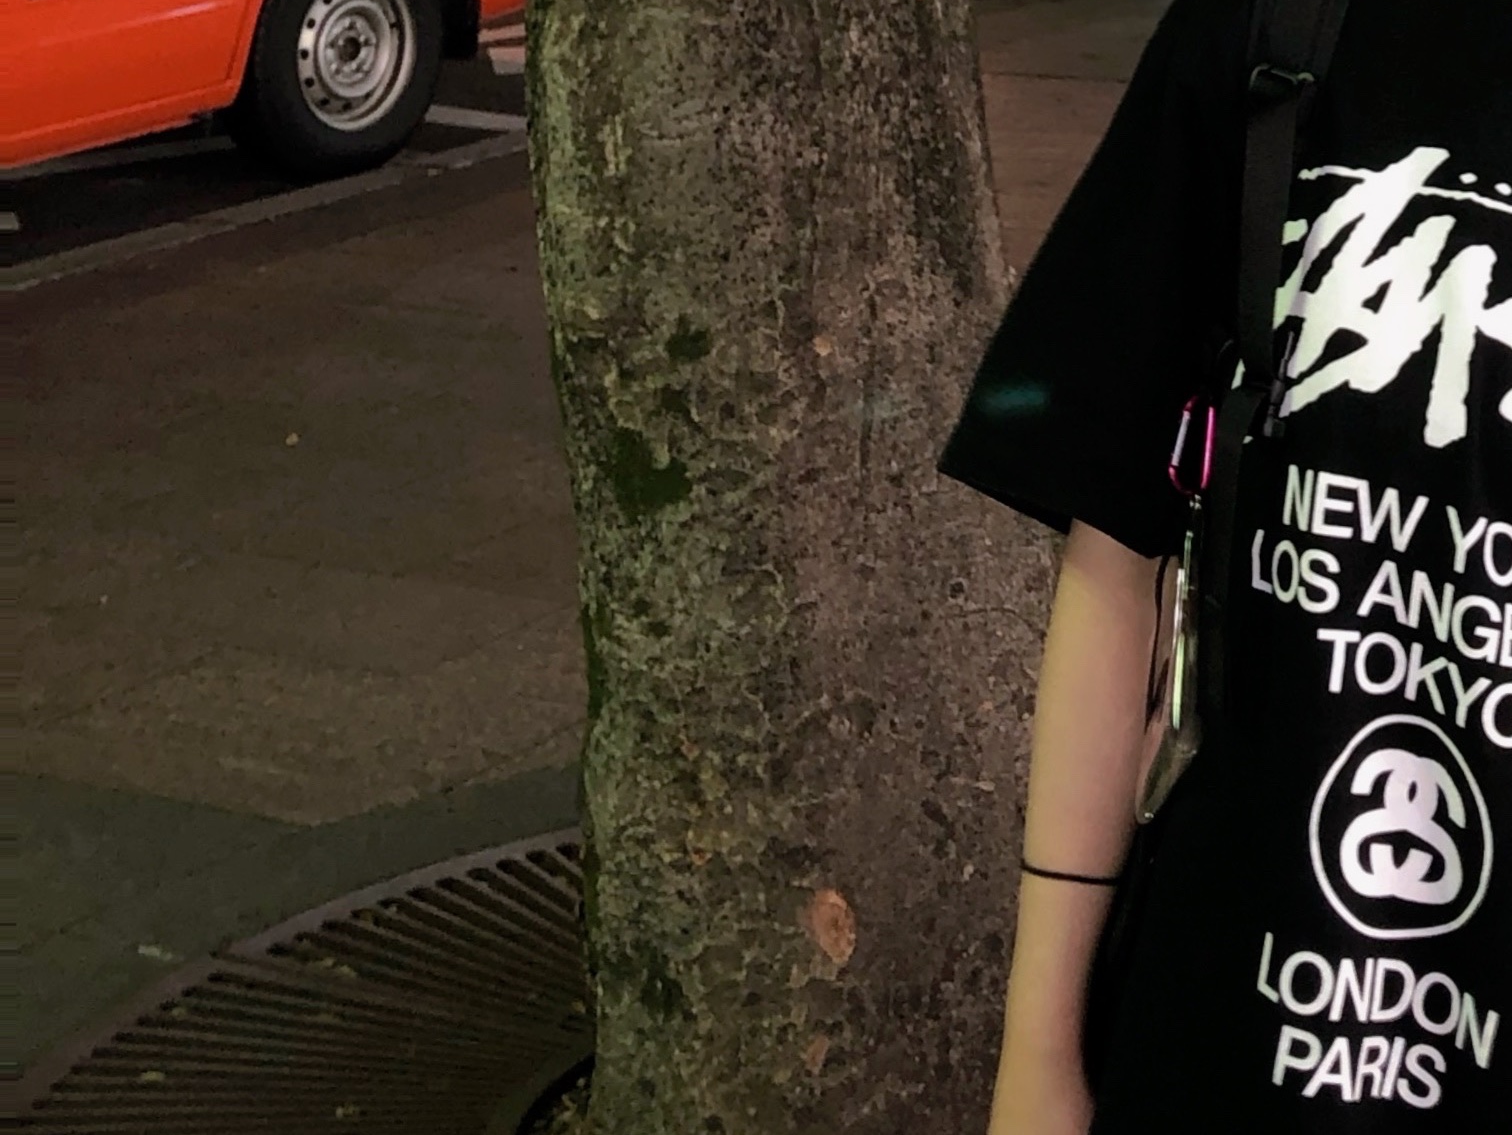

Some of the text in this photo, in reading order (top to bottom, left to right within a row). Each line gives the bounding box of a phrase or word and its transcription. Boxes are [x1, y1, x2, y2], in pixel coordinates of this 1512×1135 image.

[1283, 465, 1429, 553] NEW
[1252, 530, 1340, 614] LOS
[1257, 932, 1499, 1069] LONDON
[1272, 1025, 1446, 1109] PARIS
